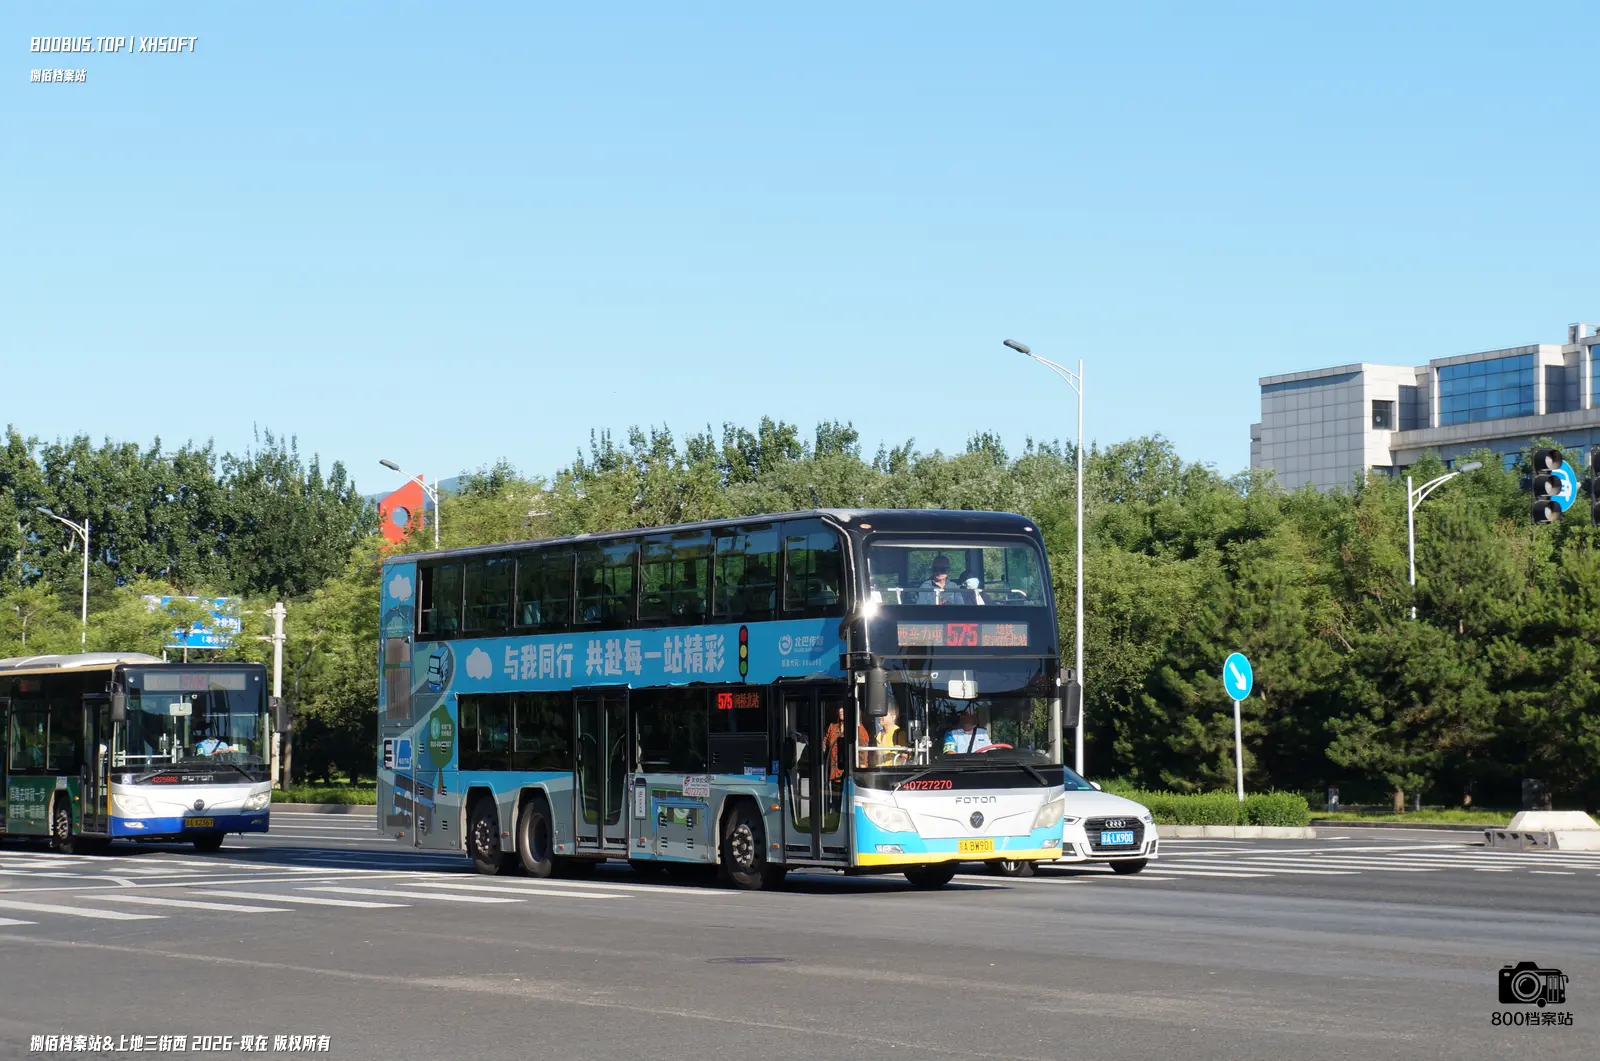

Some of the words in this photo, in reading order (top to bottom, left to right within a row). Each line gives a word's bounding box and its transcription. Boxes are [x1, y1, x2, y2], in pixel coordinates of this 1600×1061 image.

[947, 623, 978, 646] 575
[503, 643, 574, 680] 与我同行
[585, 634, 725, 677] 共赴每一站精彩
[717, 693, 733, 709] 575
[955, 796, 997, 804] FOTON
